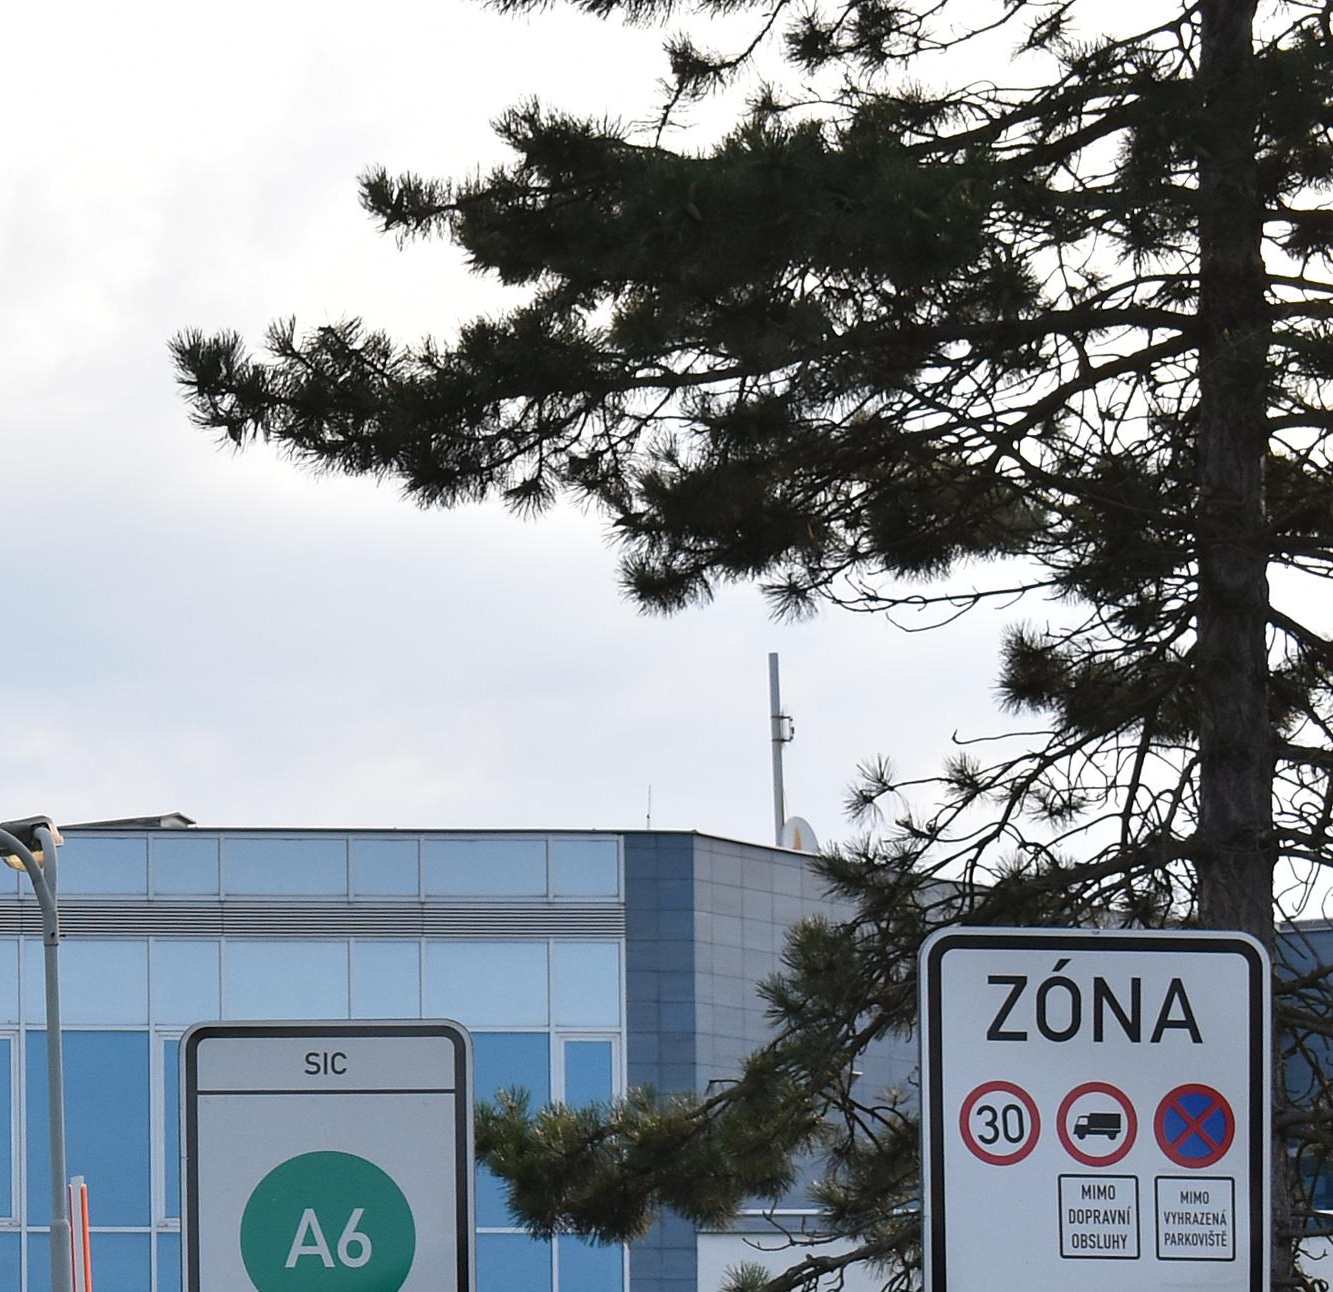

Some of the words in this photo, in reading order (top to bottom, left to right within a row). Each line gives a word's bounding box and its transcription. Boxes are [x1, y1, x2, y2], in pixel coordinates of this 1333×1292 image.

[986, 957, 1204, 1044] ZÓNA
[304, 1051, 347, 1076] SIC
[975, 1103, 1026, 1146] 30
[1081, 1184, 1116, 1201] MIMO
[1180, 1190, 1210, 1205] MIMO
[1068, 1206, 1131, 1225] DOPRAVNÍ
[1163, 1209, 1227, 1226] VYHRAZENÁ
[284, 1207, 372, 1268] A6
[1071, 1233, 1128, 1250] OBSLUHY
[1164, 1230, 1227, 1247] PARKOVIŠTĚ
